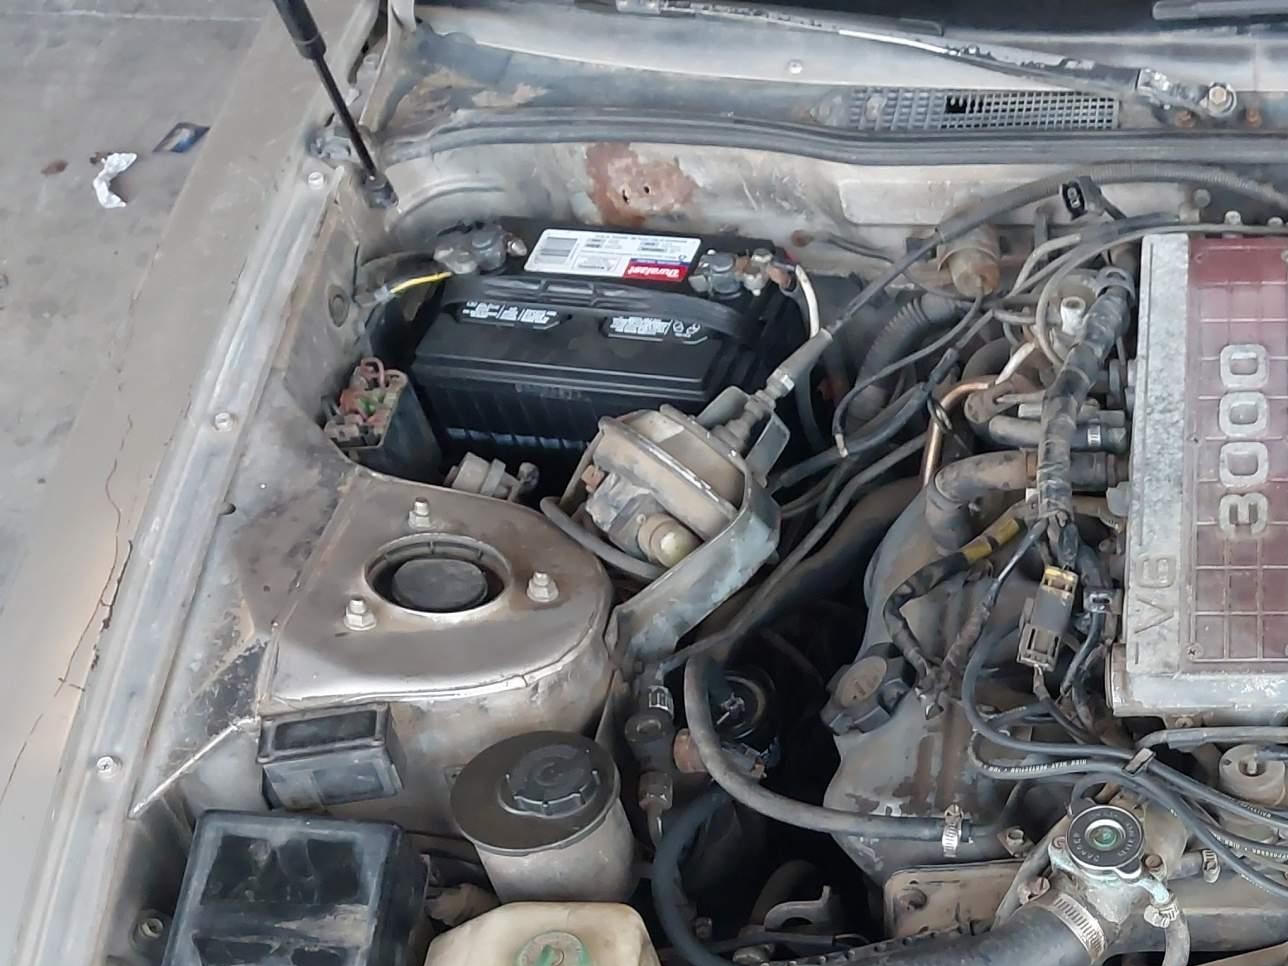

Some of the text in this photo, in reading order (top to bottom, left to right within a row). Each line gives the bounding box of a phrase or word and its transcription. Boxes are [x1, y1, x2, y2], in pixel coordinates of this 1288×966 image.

[627, 265, 680, 279] Duralast
[1217, 343, 1270, 541] 3000
[1131, 553, 1178, 636] V6
